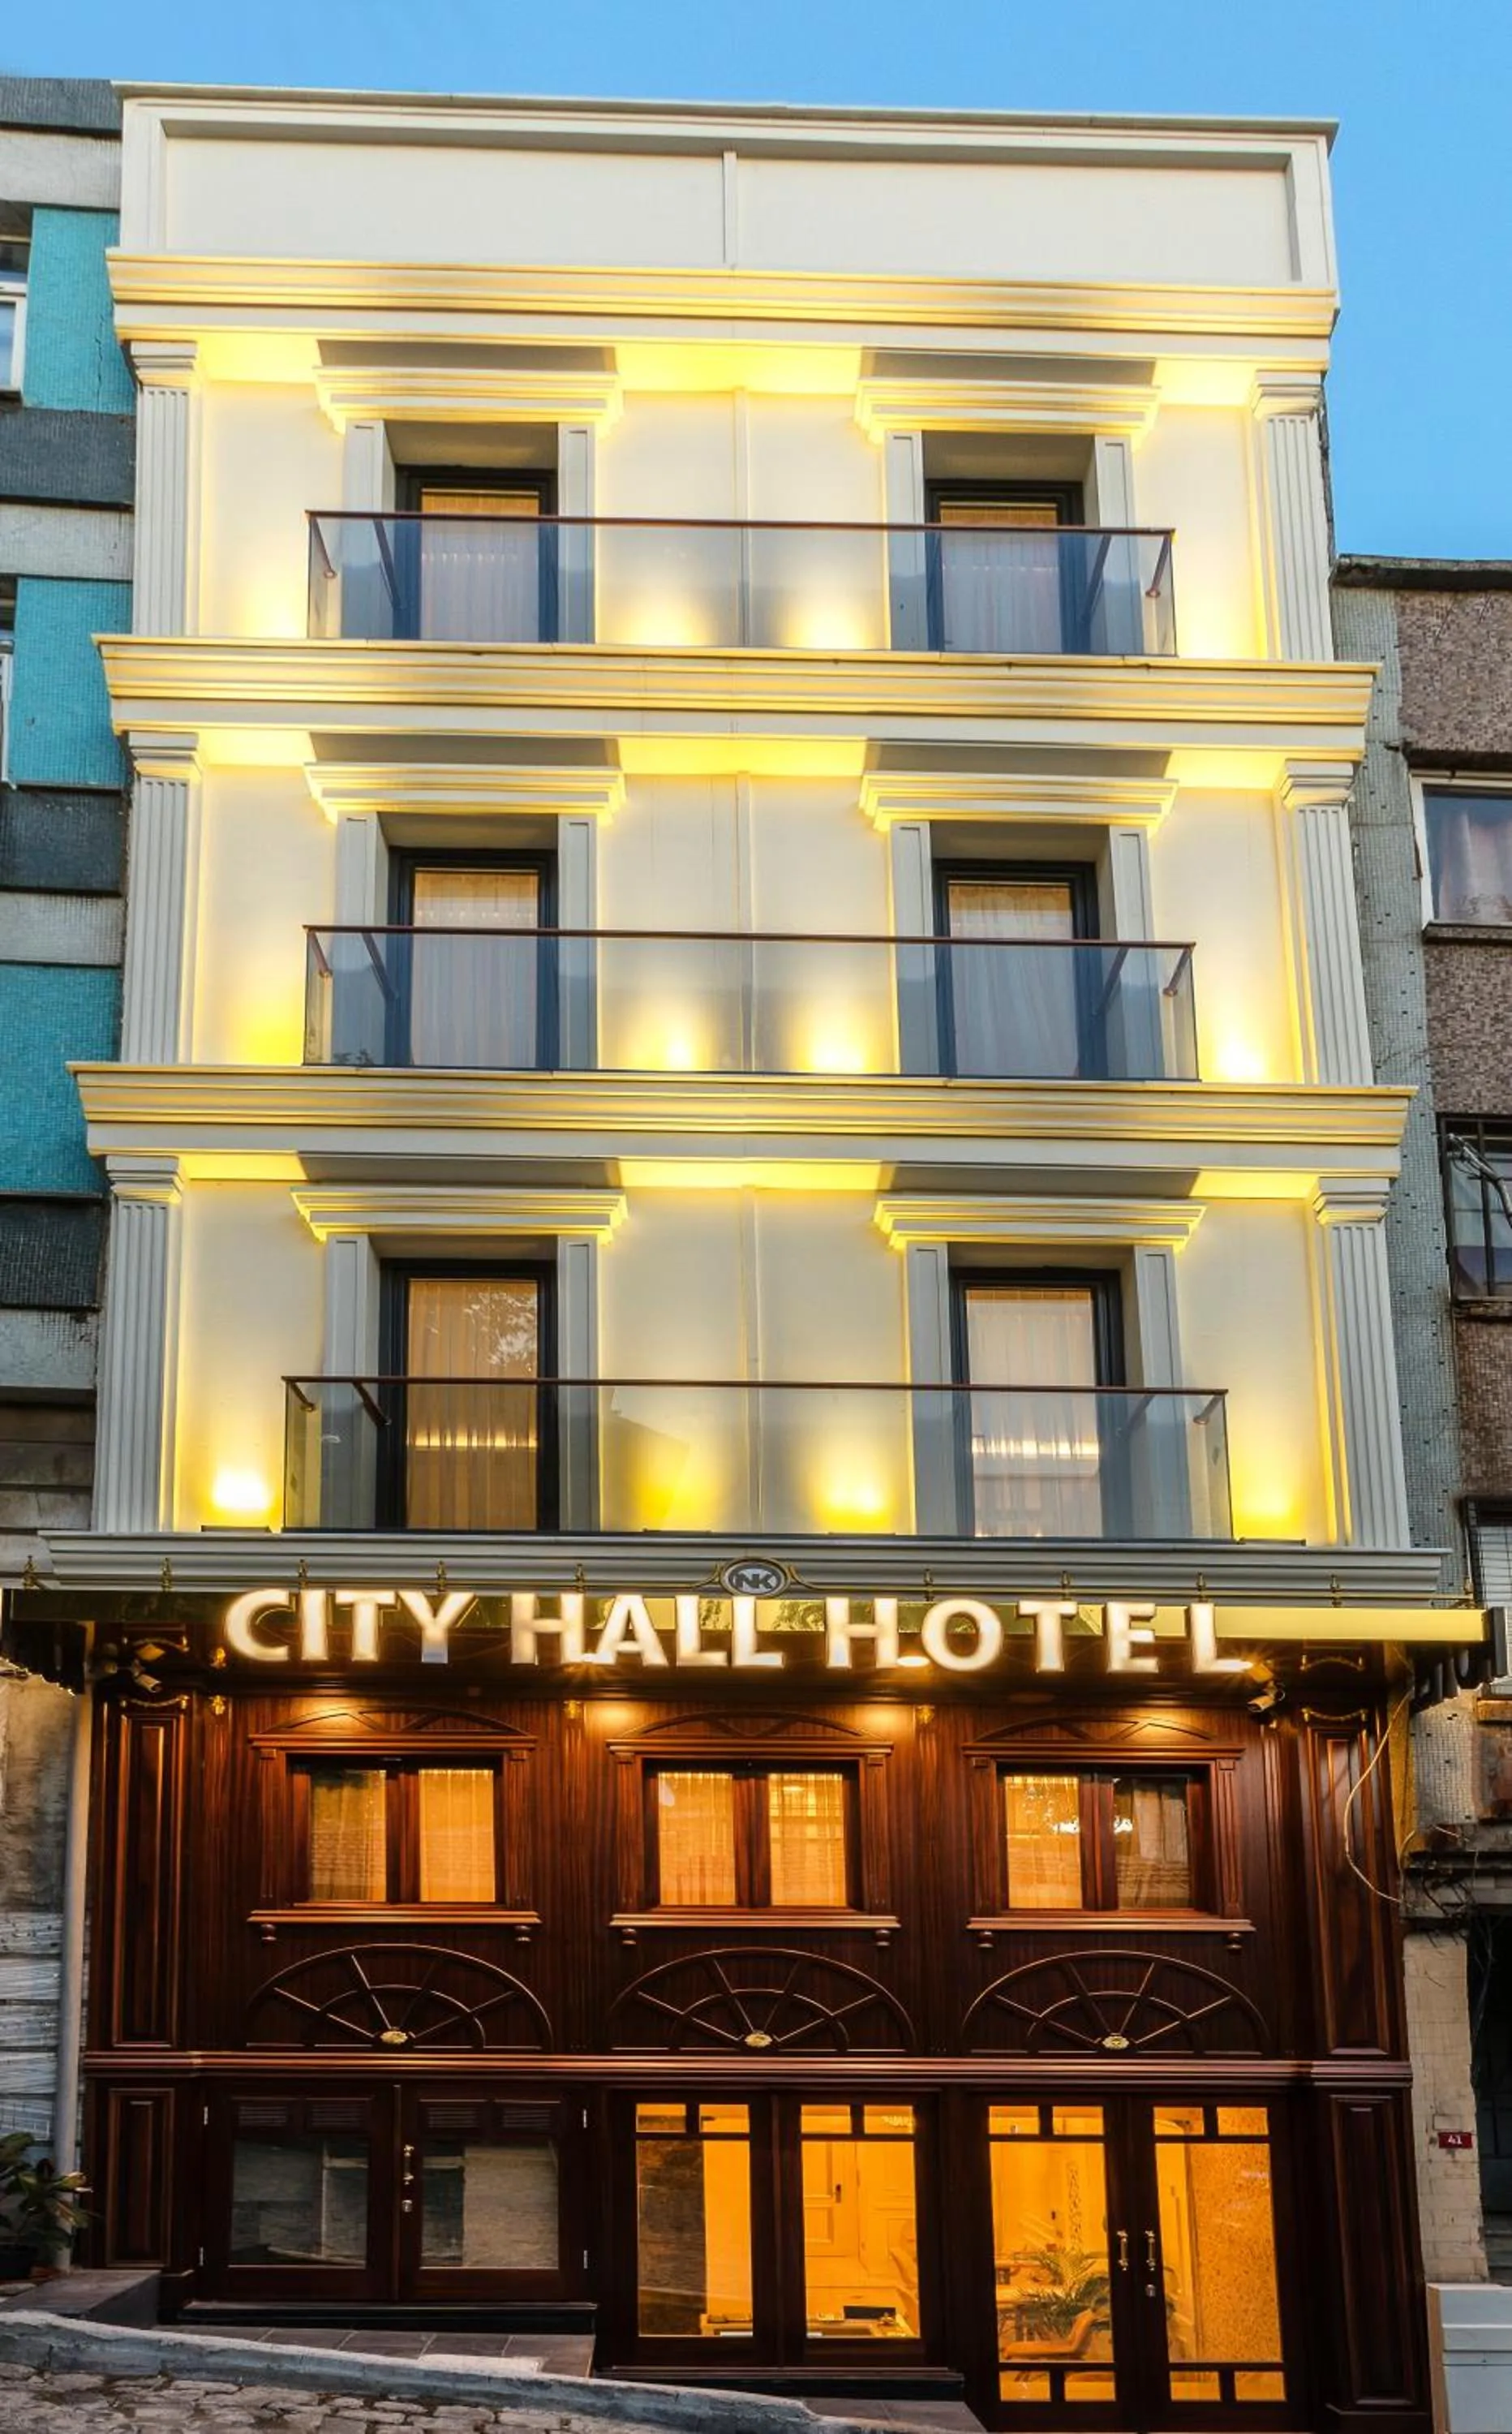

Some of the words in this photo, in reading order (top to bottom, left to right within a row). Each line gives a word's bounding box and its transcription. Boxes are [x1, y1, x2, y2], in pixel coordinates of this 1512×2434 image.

[224, 1589, 475, 1664] CITY
[509, 1593, 783, 1668] HALL
[825, 1597, 1254, 1673] HOTEL
[1448, 2135, 1463, 2145] 41
